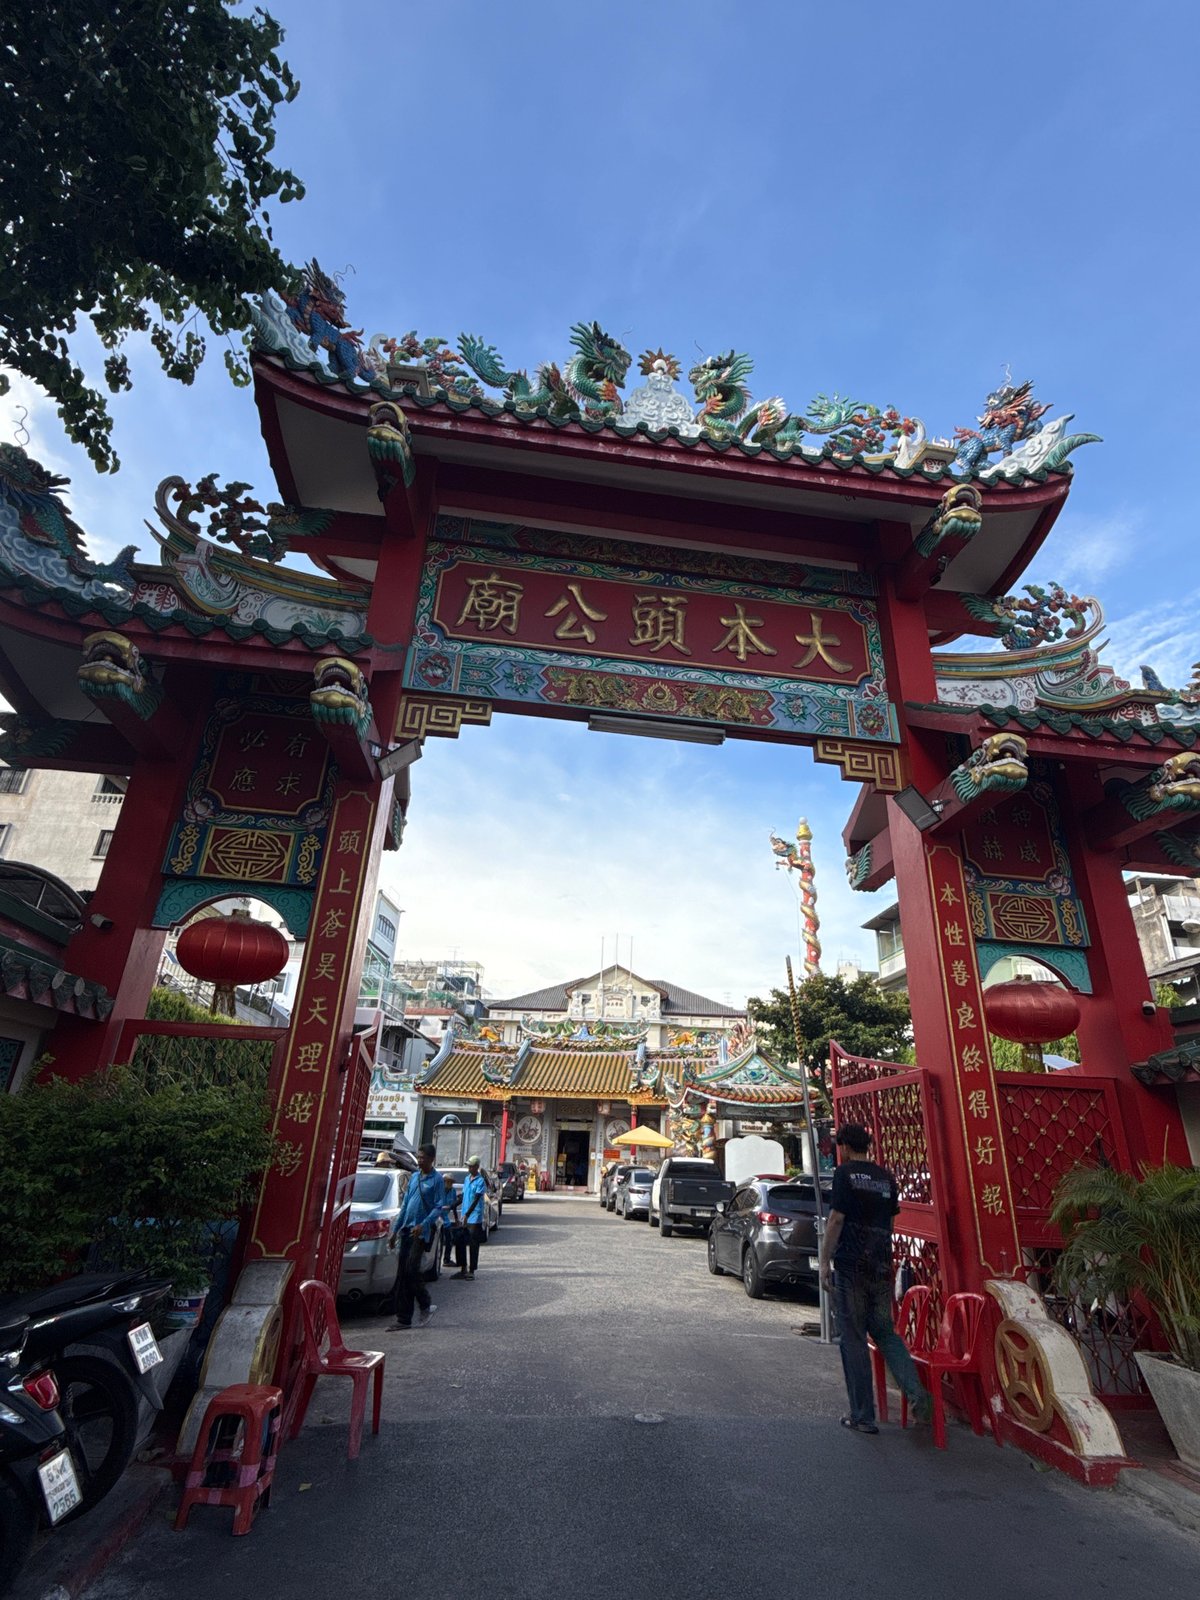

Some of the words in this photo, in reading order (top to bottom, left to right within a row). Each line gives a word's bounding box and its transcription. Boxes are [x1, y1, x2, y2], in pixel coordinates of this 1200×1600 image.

[940, 882, 1006, 1216] 本性善良終得好報
[53, 1488, 77, 1518] 2565
